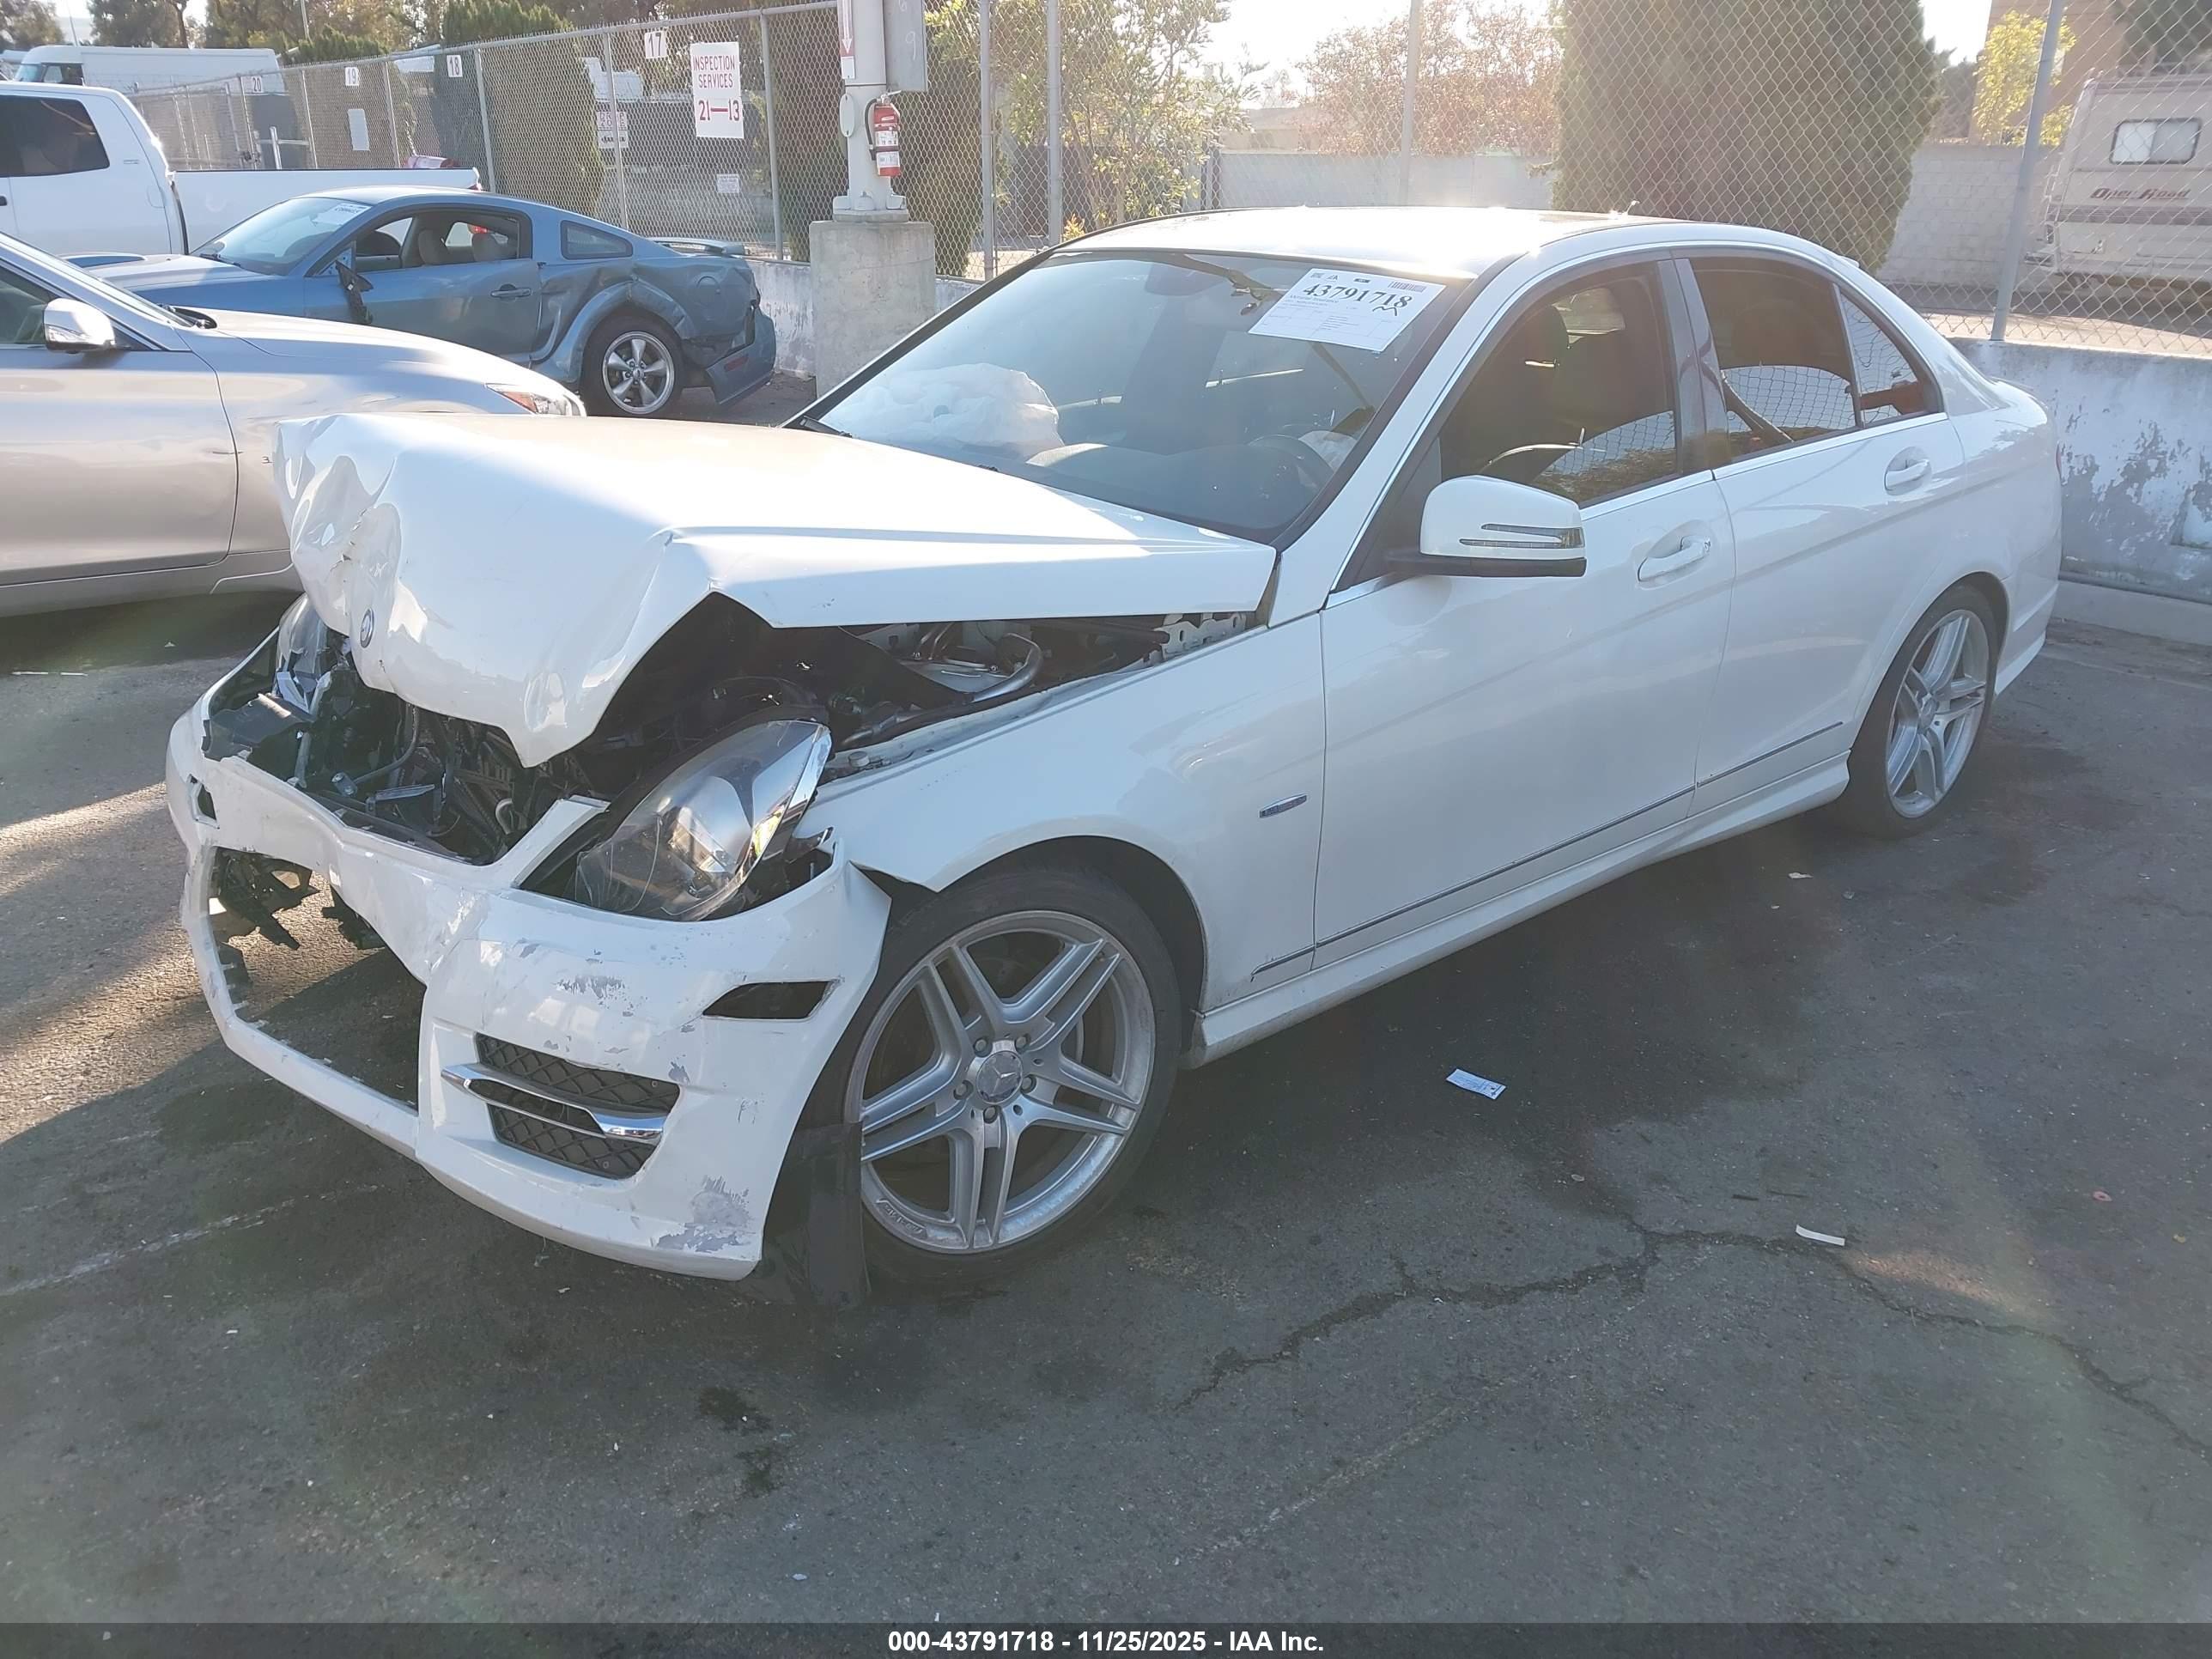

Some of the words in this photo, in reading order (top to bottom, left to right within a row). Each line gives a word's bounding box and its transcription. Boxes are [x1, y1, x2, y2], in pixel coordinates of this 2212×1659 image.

[648, 33, 662, 57] 17
[448, 58, 461, 76] 18
[693, 55, 735, 70] INSPECTION
[347, 68, 356, 84] 19
[699, 74, 733, 88] SERVICES
[252, 77, 262, 92] 20
[1303, 283, 1413, 308] 43791718
